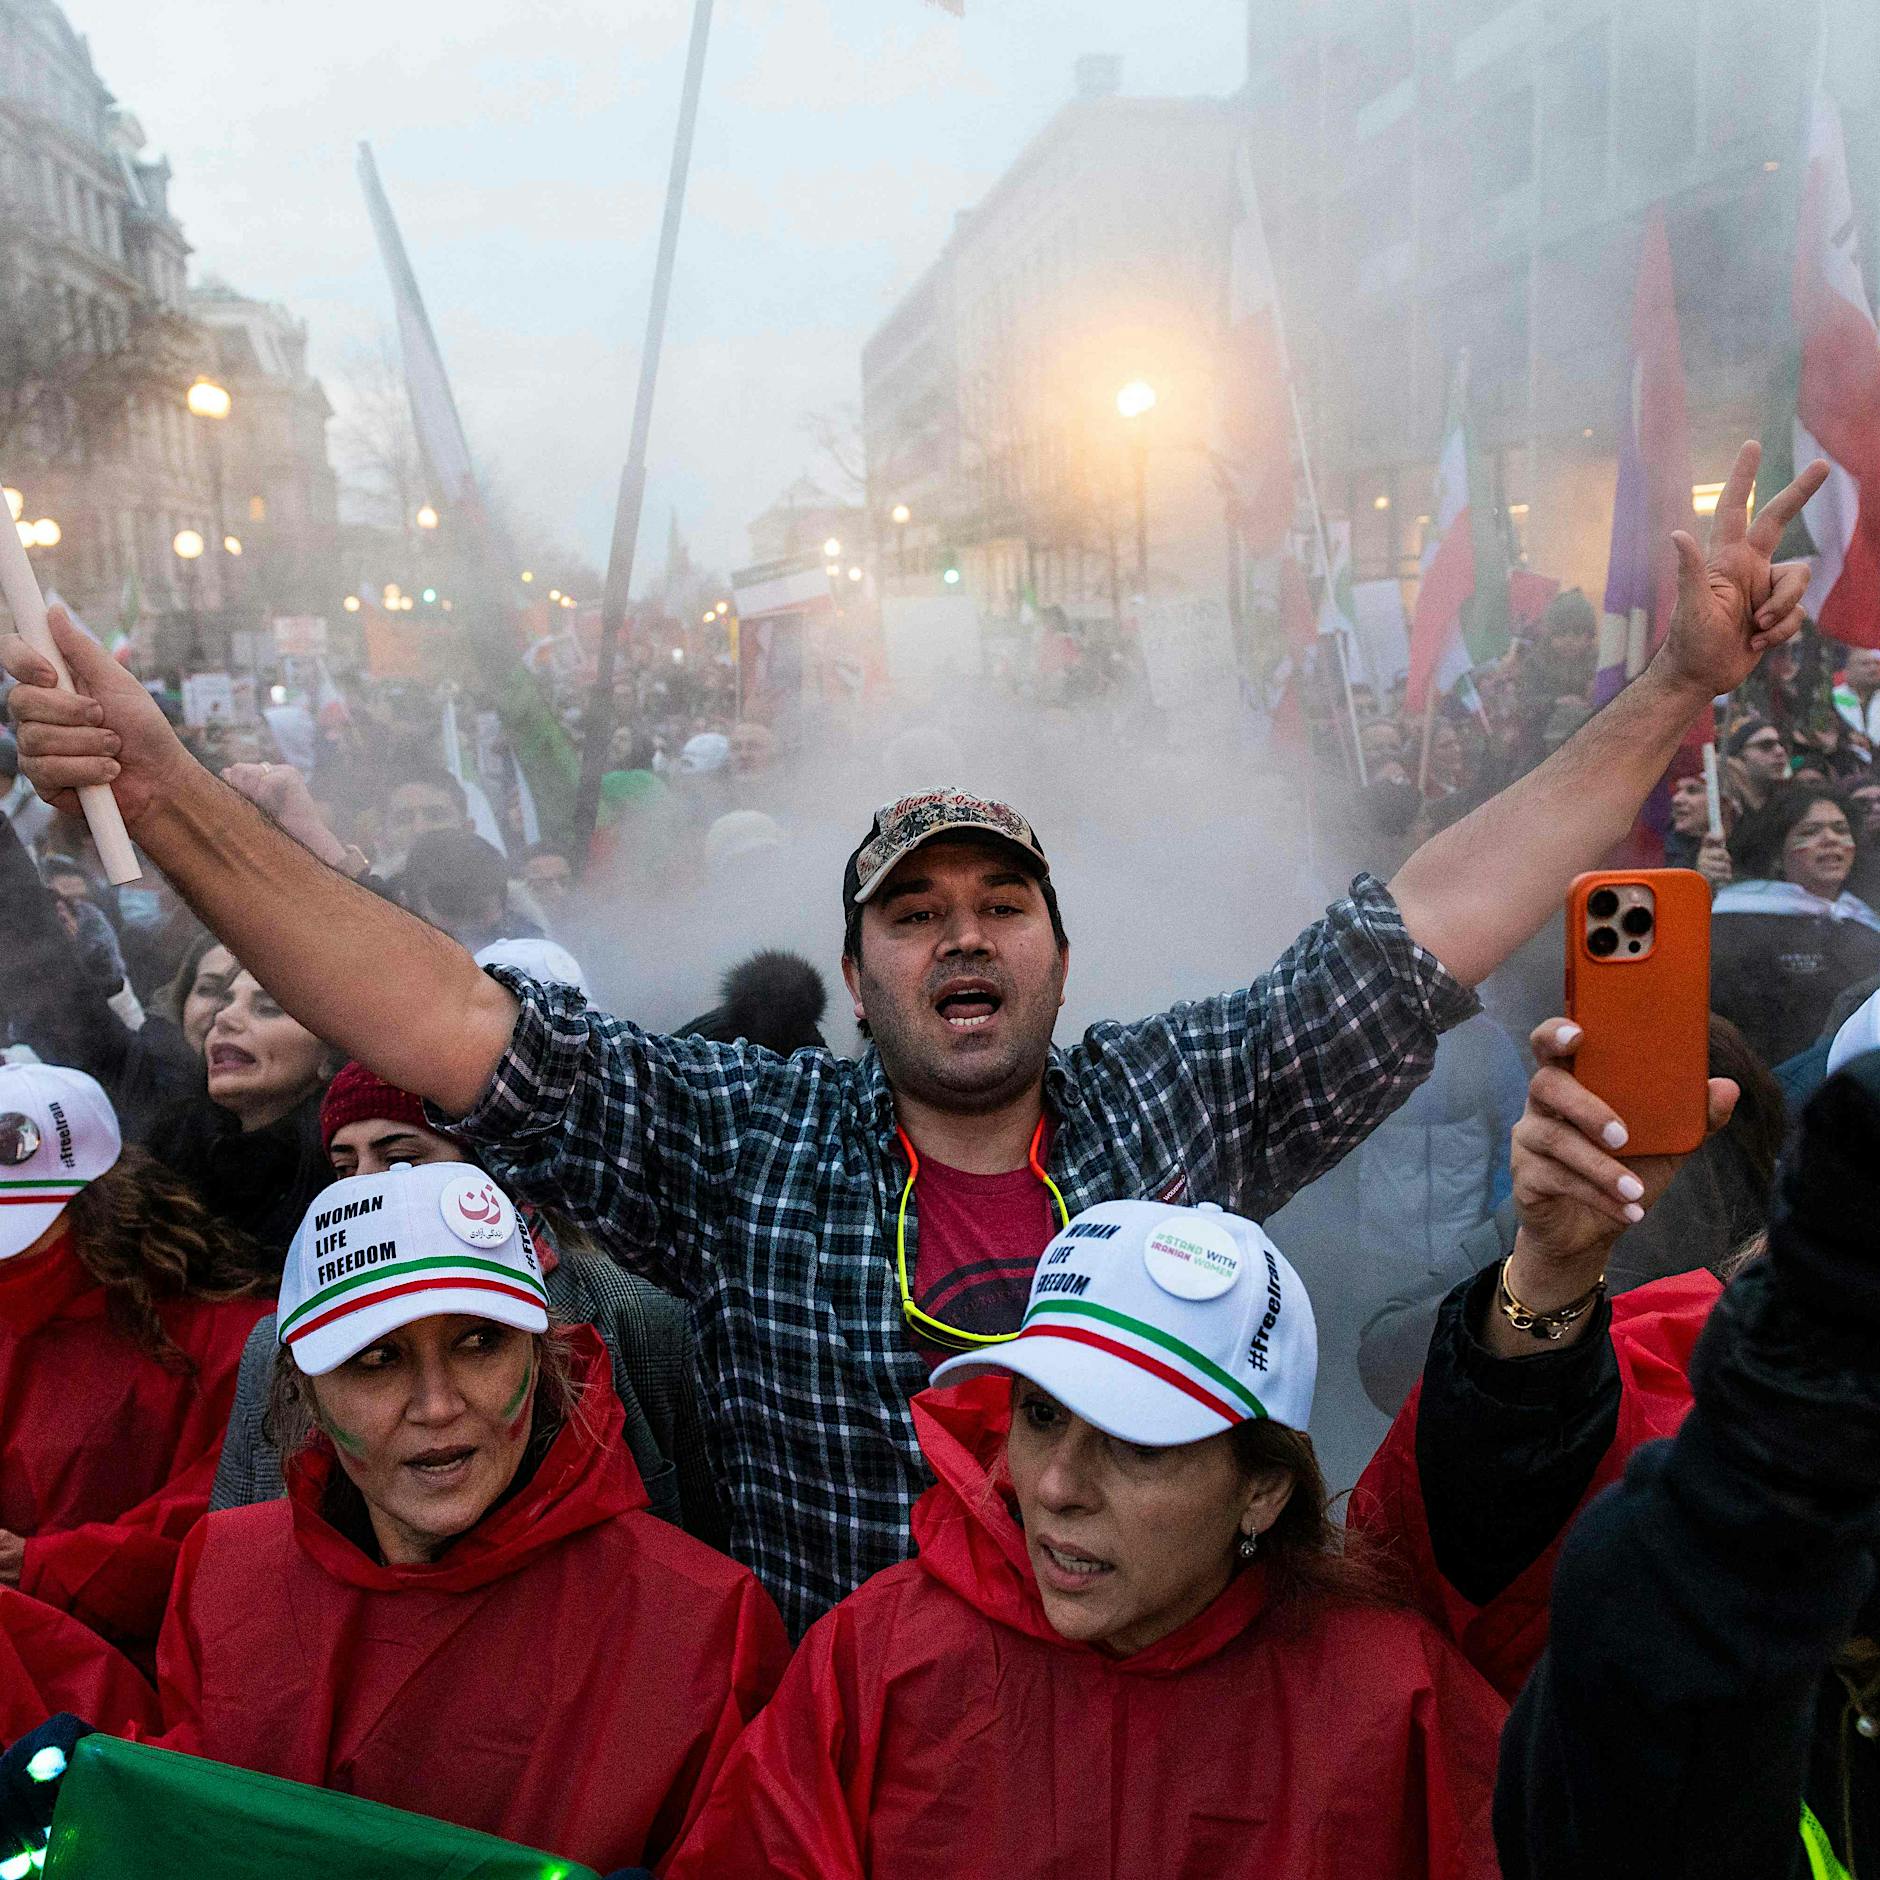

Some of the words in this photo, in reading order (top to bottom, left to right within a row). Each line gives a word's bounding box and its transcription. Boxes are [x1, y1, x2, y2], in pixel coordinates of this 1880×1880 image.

[48, 1102, 76, 1169] #FreeIran
[315, 1195, 384, 1231] WOMAN
[458, 1184, 501, 1225] زن
[315, 1229, 347, 1259] LIFE
[1065, 1223, 1122, 1240] WOMAN
[318, 1241, 397, 1286] FREEDOM
[1047, 1246, 1075, 1265] LIFE
[1150, 1241, 1192, 1262] IRANIAN
[1193, 1256, 1234, 1278] WOMEN
[1155, 1232, 1203, 1255] #STAND
[1206, 1249, 1237, 1270] WITH
[1035, 1273, 1092, 1296] FREEDOM
[1247, 1250, 1281, 1371] #FreeIran
